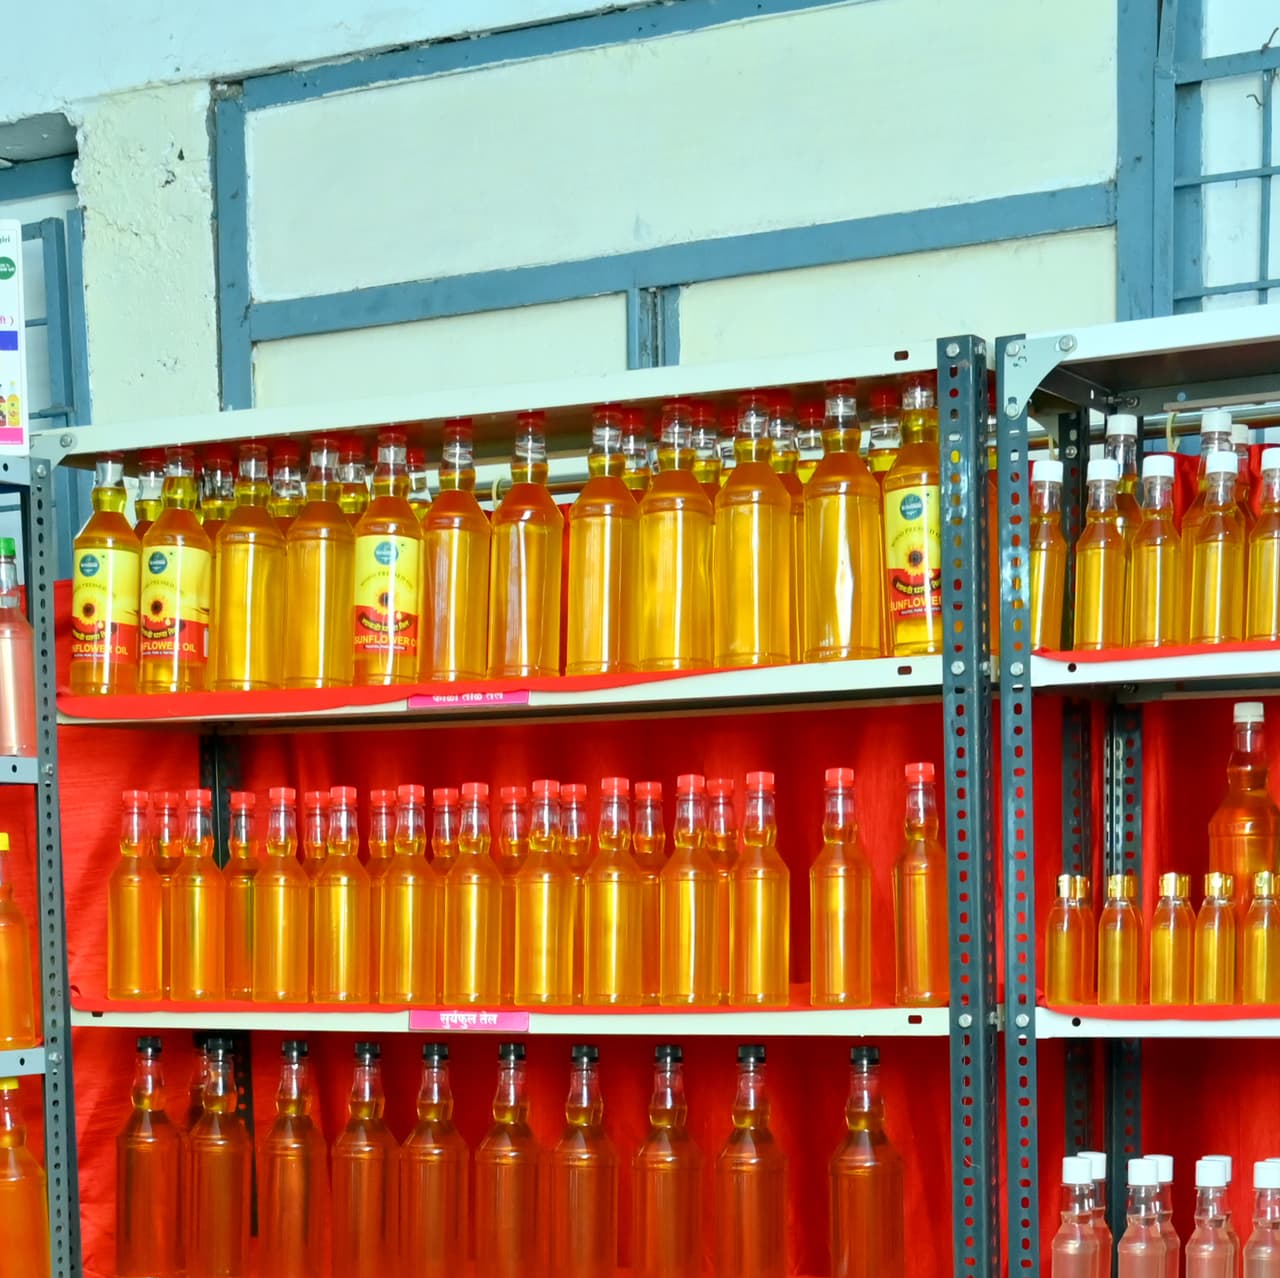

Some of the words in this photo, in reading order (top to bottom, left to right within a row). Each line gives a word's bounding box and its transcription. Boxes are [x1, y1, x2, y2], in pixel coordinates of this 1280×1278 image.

[115, 646, 129, 656] OIL
[183, 643, 197, 653] OIL
[479, 1010, 498, 1025] तेल
